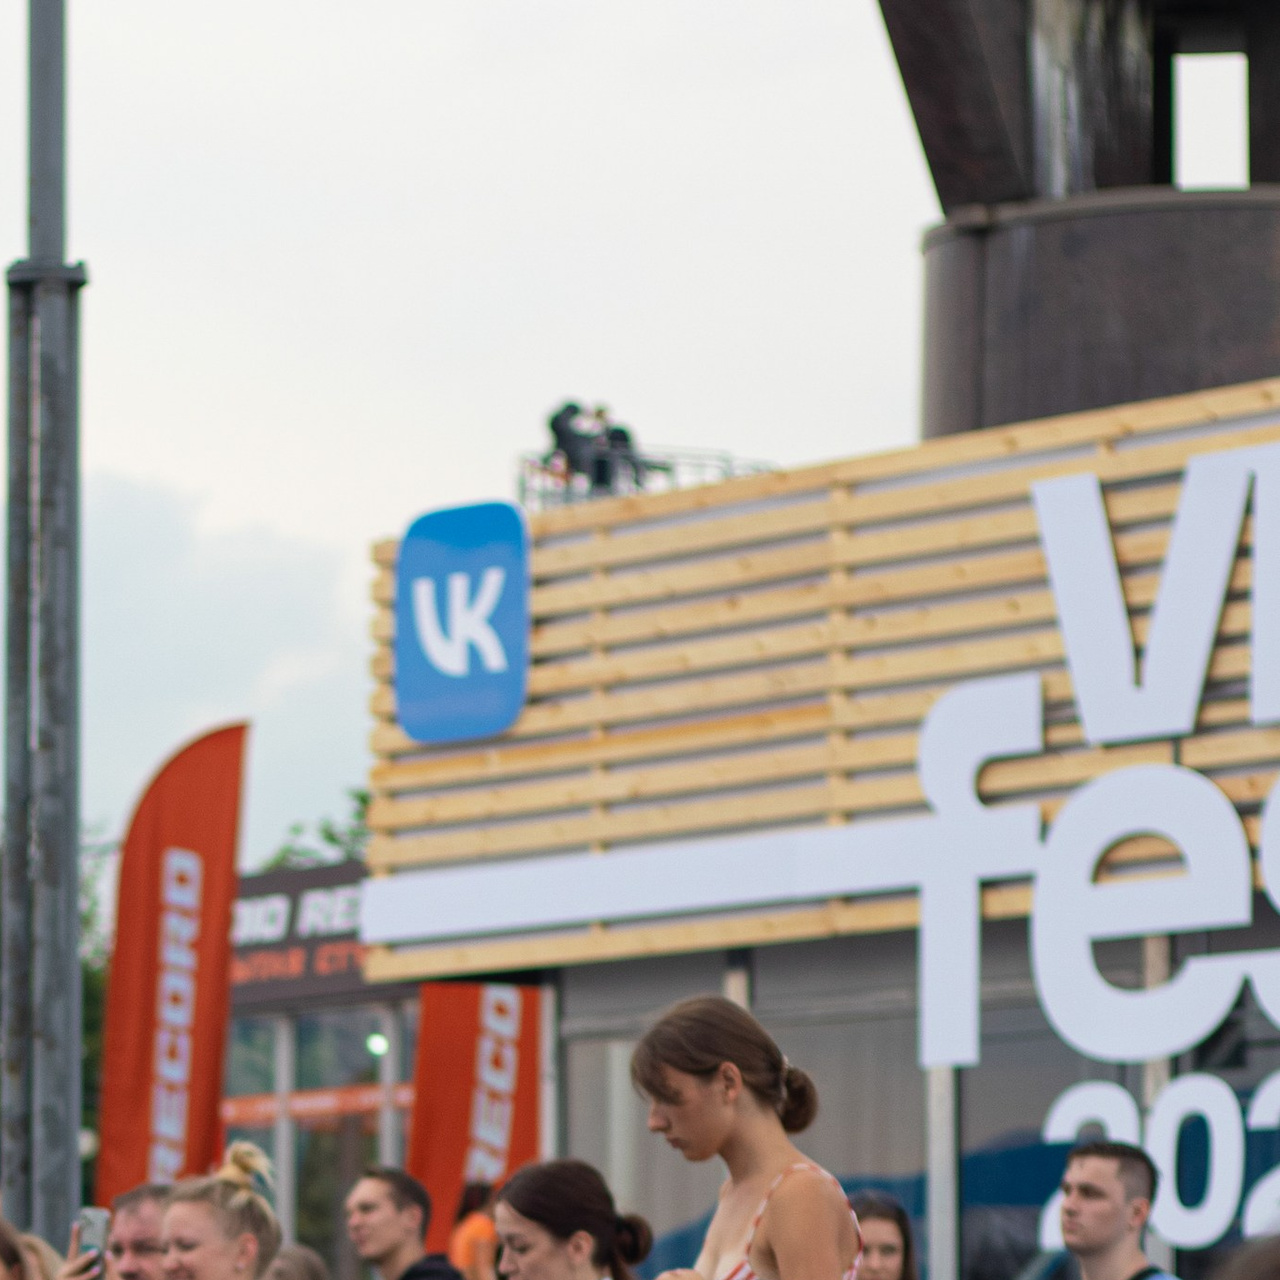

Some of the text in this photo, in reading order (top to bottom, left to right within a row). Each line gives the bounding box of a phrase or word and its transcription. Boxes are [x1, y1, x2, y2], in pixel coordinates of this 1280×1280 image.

[411, 566, 509, 679] VK
[1030, 440, 1280, 746] V
[147, 846, 205, 1187] RECORD
[918, 672, 1280, 1066] fe
